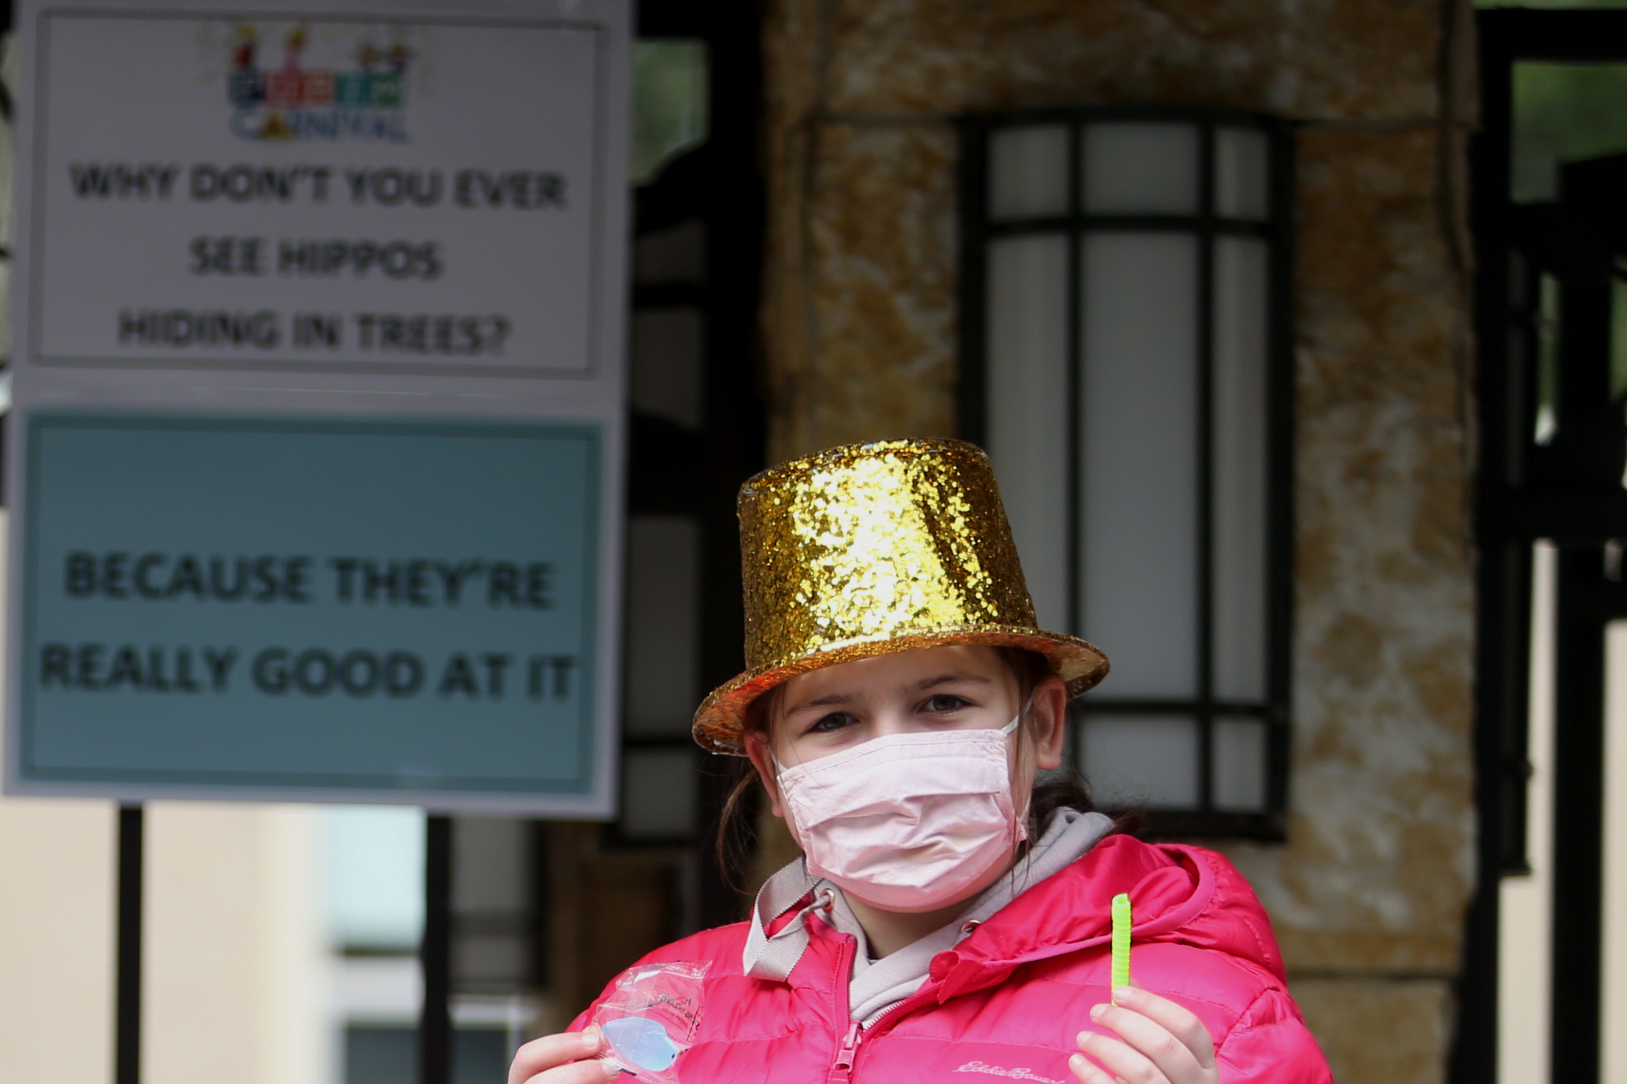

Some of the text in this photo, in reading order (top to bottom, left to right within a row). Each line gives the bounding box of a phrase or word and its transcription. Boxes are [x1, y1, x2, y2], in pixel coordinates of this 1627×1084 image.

[70, 163, 568, 210] WHY DON'T YOU EVER
[189, 236, 444, 281] SEE HIPPOS
[118, 309, 512, 356] HIDING IN TREES?
[64, 551, 556, 610] BECAUSE THEY'RE
[39, 642, 579, 700] REALLY GOOD AT IT
[952, 1061, 1006, 1077] Eddie
